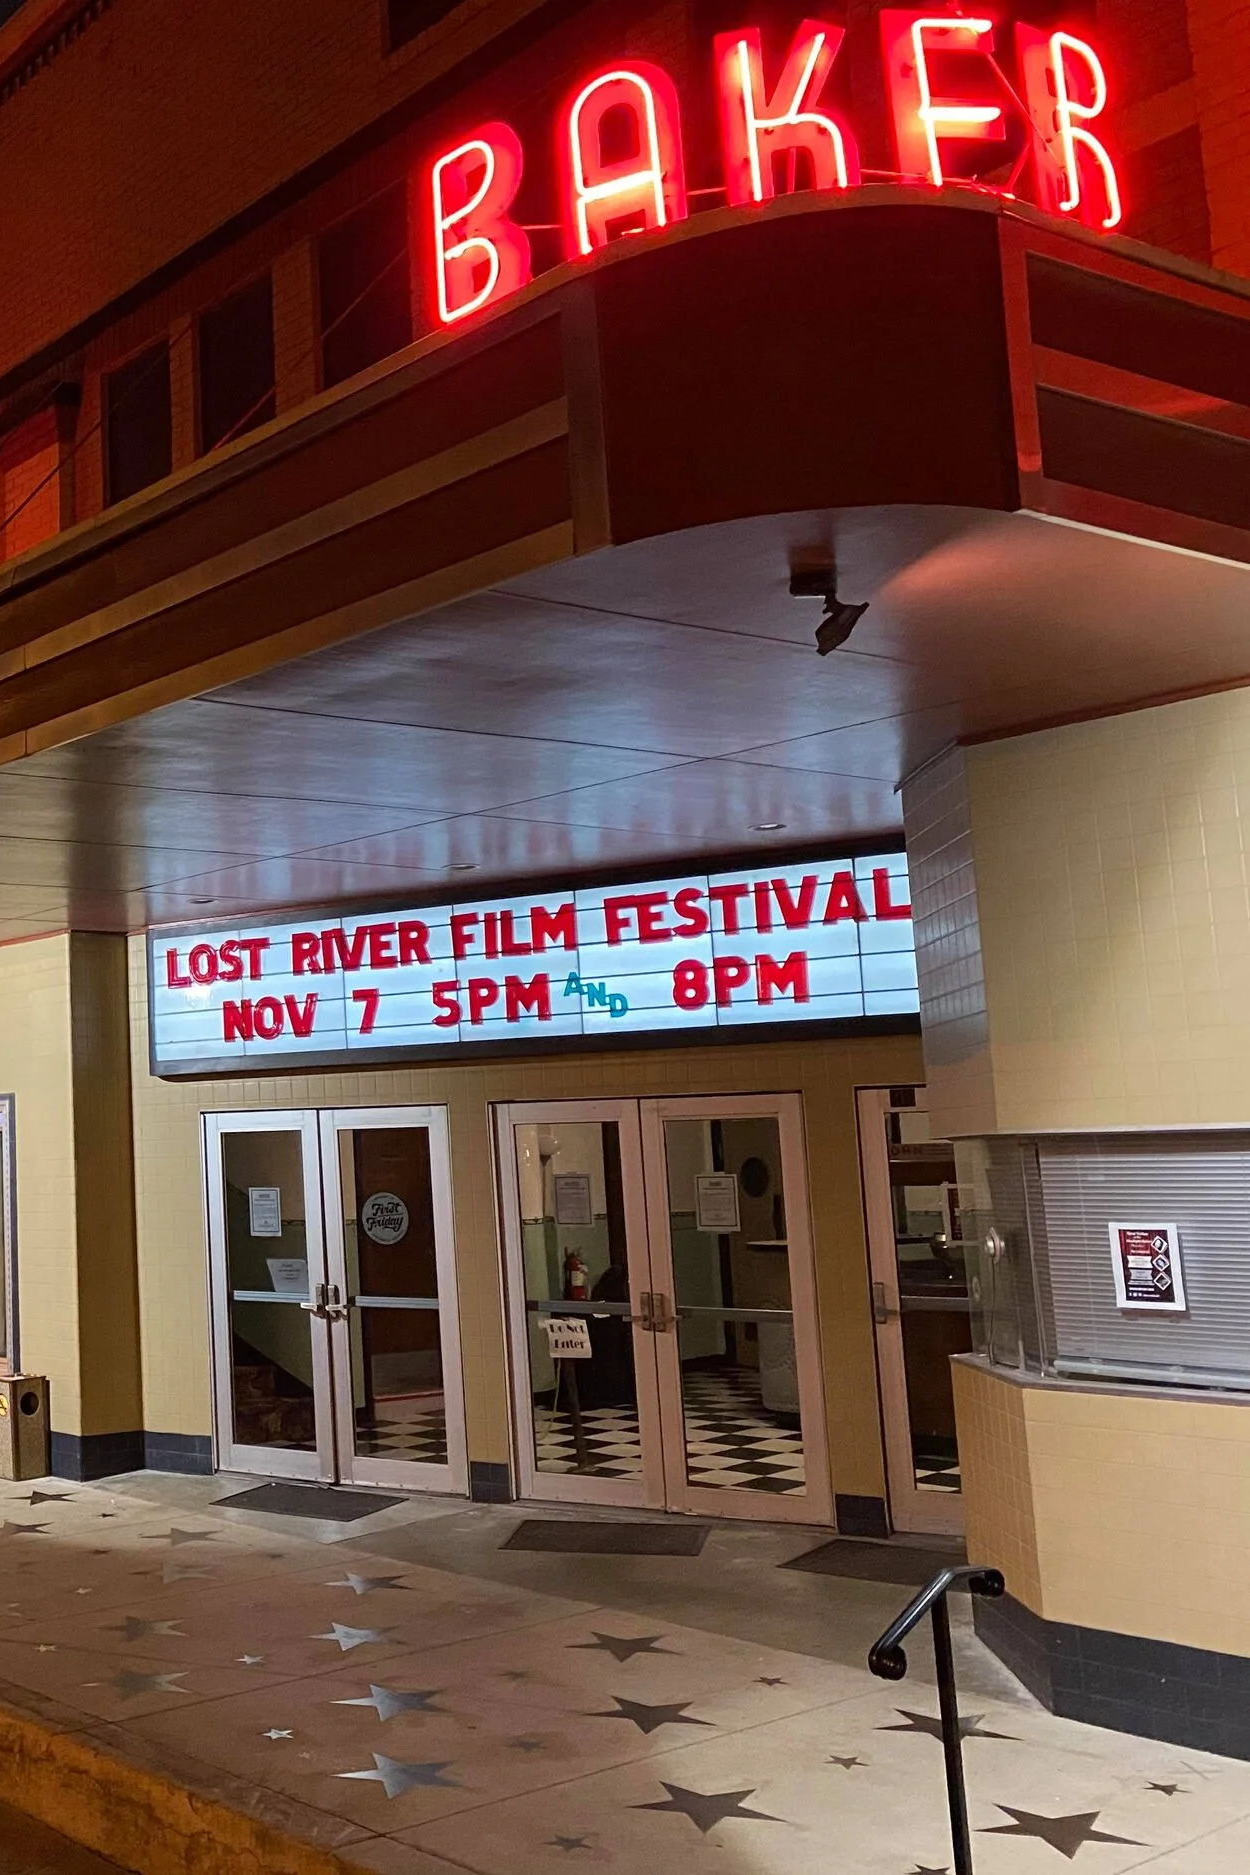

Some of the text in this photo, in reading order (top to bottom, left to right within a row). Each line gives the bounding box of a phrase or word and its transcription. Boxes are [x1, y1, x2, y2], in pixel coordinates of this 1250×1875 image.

[432, 9, 1122, 324] BAKER
[166, 867, 913, 989] LOST RIVER FILM FESTIVAL
[222, 951, 809, 1043] NOV 7 5PM AND 8PM
[366, 1215, 403, 1232] Friday
[371, 1202, 402, 1216] First
